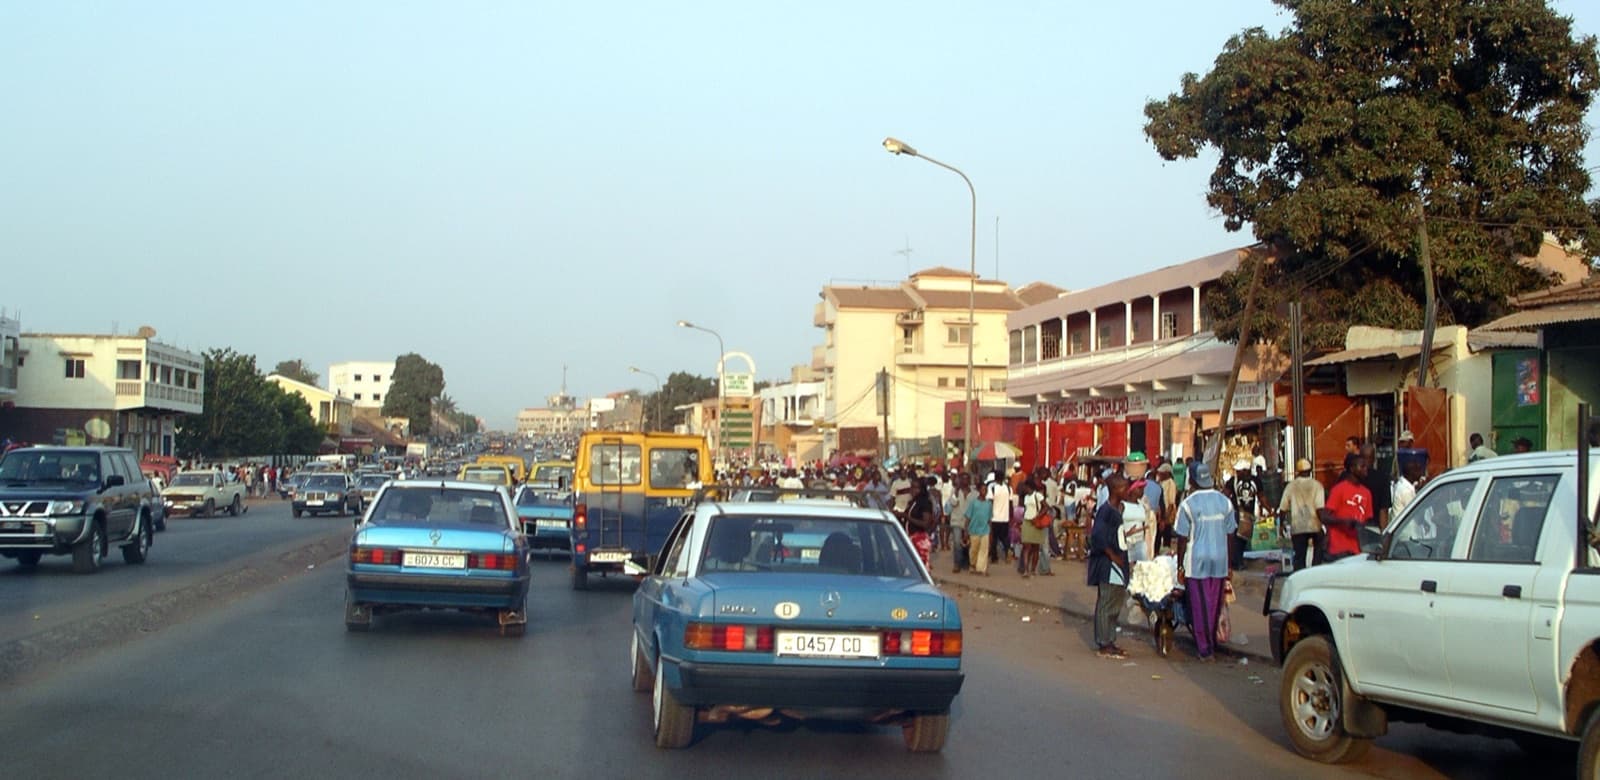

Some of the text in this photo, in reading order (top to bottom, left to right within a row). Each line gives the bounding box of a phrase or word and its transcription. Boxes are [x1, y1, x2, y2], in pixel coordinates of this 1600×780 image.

[414, 555, 456, 567] 6073 CC
[783, 604, 792, 616] D
[796, 637, 836, 653] 0457
